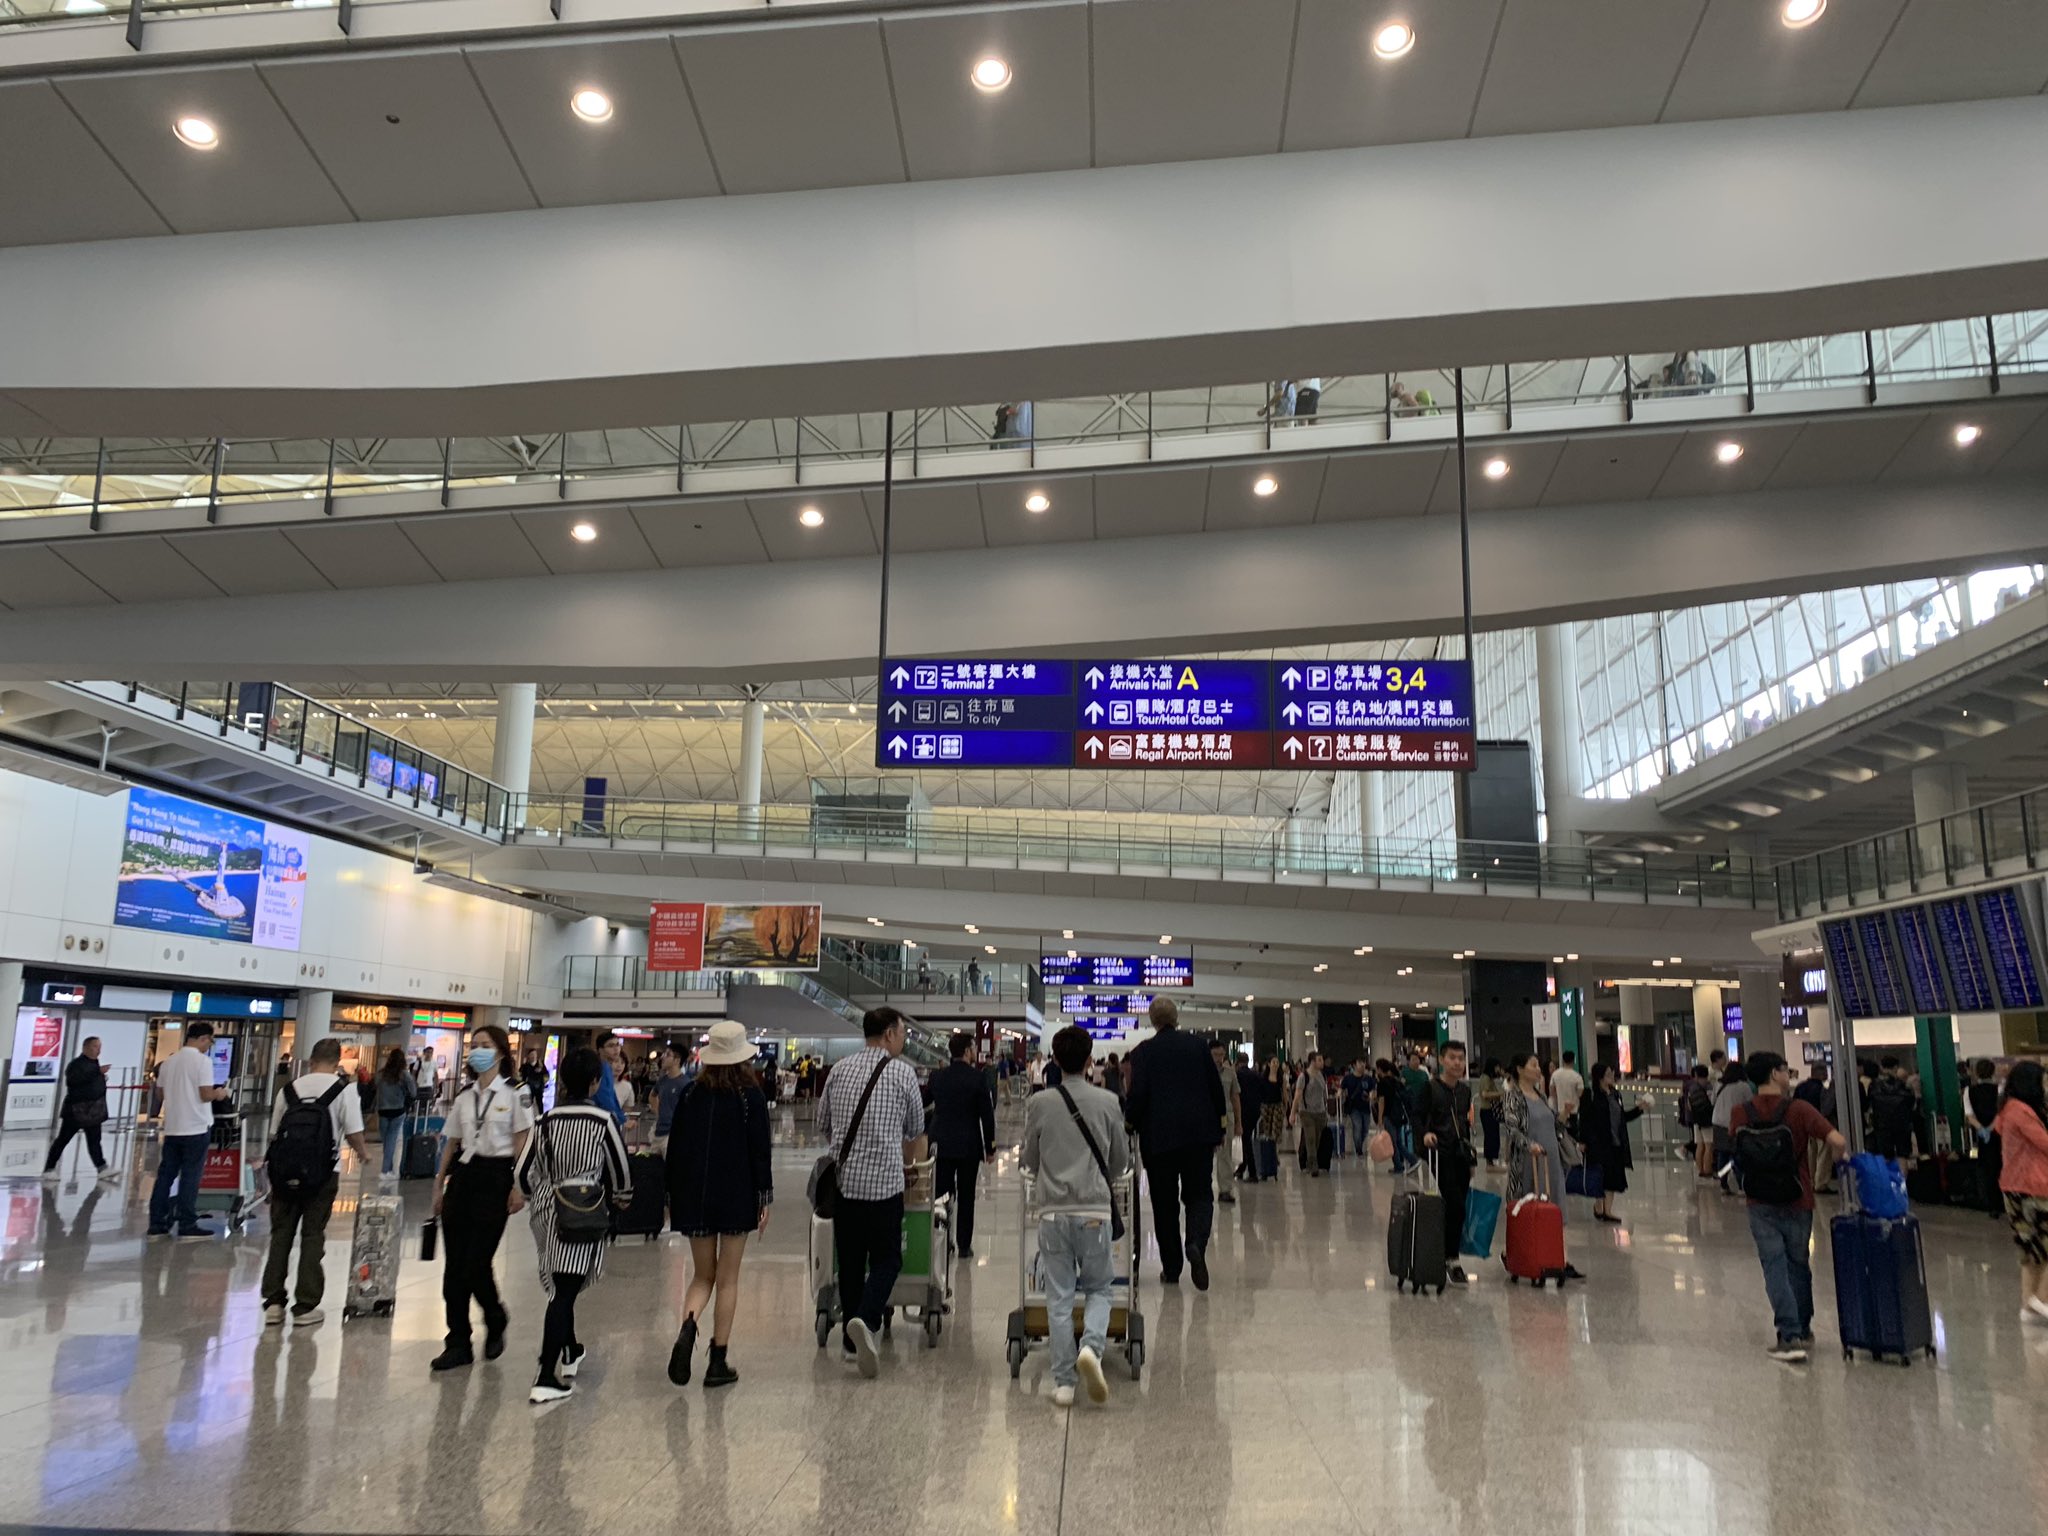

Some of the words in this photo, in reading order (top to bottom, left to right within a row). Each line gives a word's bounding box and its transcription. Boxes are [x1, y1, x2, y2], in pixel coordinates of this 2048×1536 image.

[917, 670, 936, 685] T2
[941, 664, 1036, 680] 二號客運大樓
[1110, 664, 1173, 680] 接機大堂
[1177, 666, 1199, 690] A
[1312, 669, 1327, 688] P
[1334, 665, 1382, 680] 停車場
[941, 679, 986, 690] Terminal
[987, 679, 995, 690] 2
[1110, 679, 1149, 690] Arrivals
[1152, 679, 1173, 690] Hall
[1334, 680, 1353, 691] Car
[1355, 680, 1378, 691] Park
[1386, 667, 1427, 694] 3,4
[967, 698, 1015, 713] 往市區
[1135, 699, 1234, 714] 團隊/酒店巴士
[967, 714, 980, 724] To
[982, 714, 1001, 726] city
[1136, 714, 1189, 726] Tour/Hotel
[1191, 714, 1223, 725] Coach
[1335, 715, 1421, 727] Mainland/Macao
[1422, 716, 1470, 728] Transport
[1135, 734, 1232, 749] 富豪機場酒店
[1336, 734, 1401, 750] 旅客服務
[1136, 749, 1164, 762] Regal
[1166, 749, 1203, 762] Airport
[1205, 749, 1232, 761] Hotel
[1336, 750, 1388, 762] Customer
[1390, 750, 1430, 762] Service
